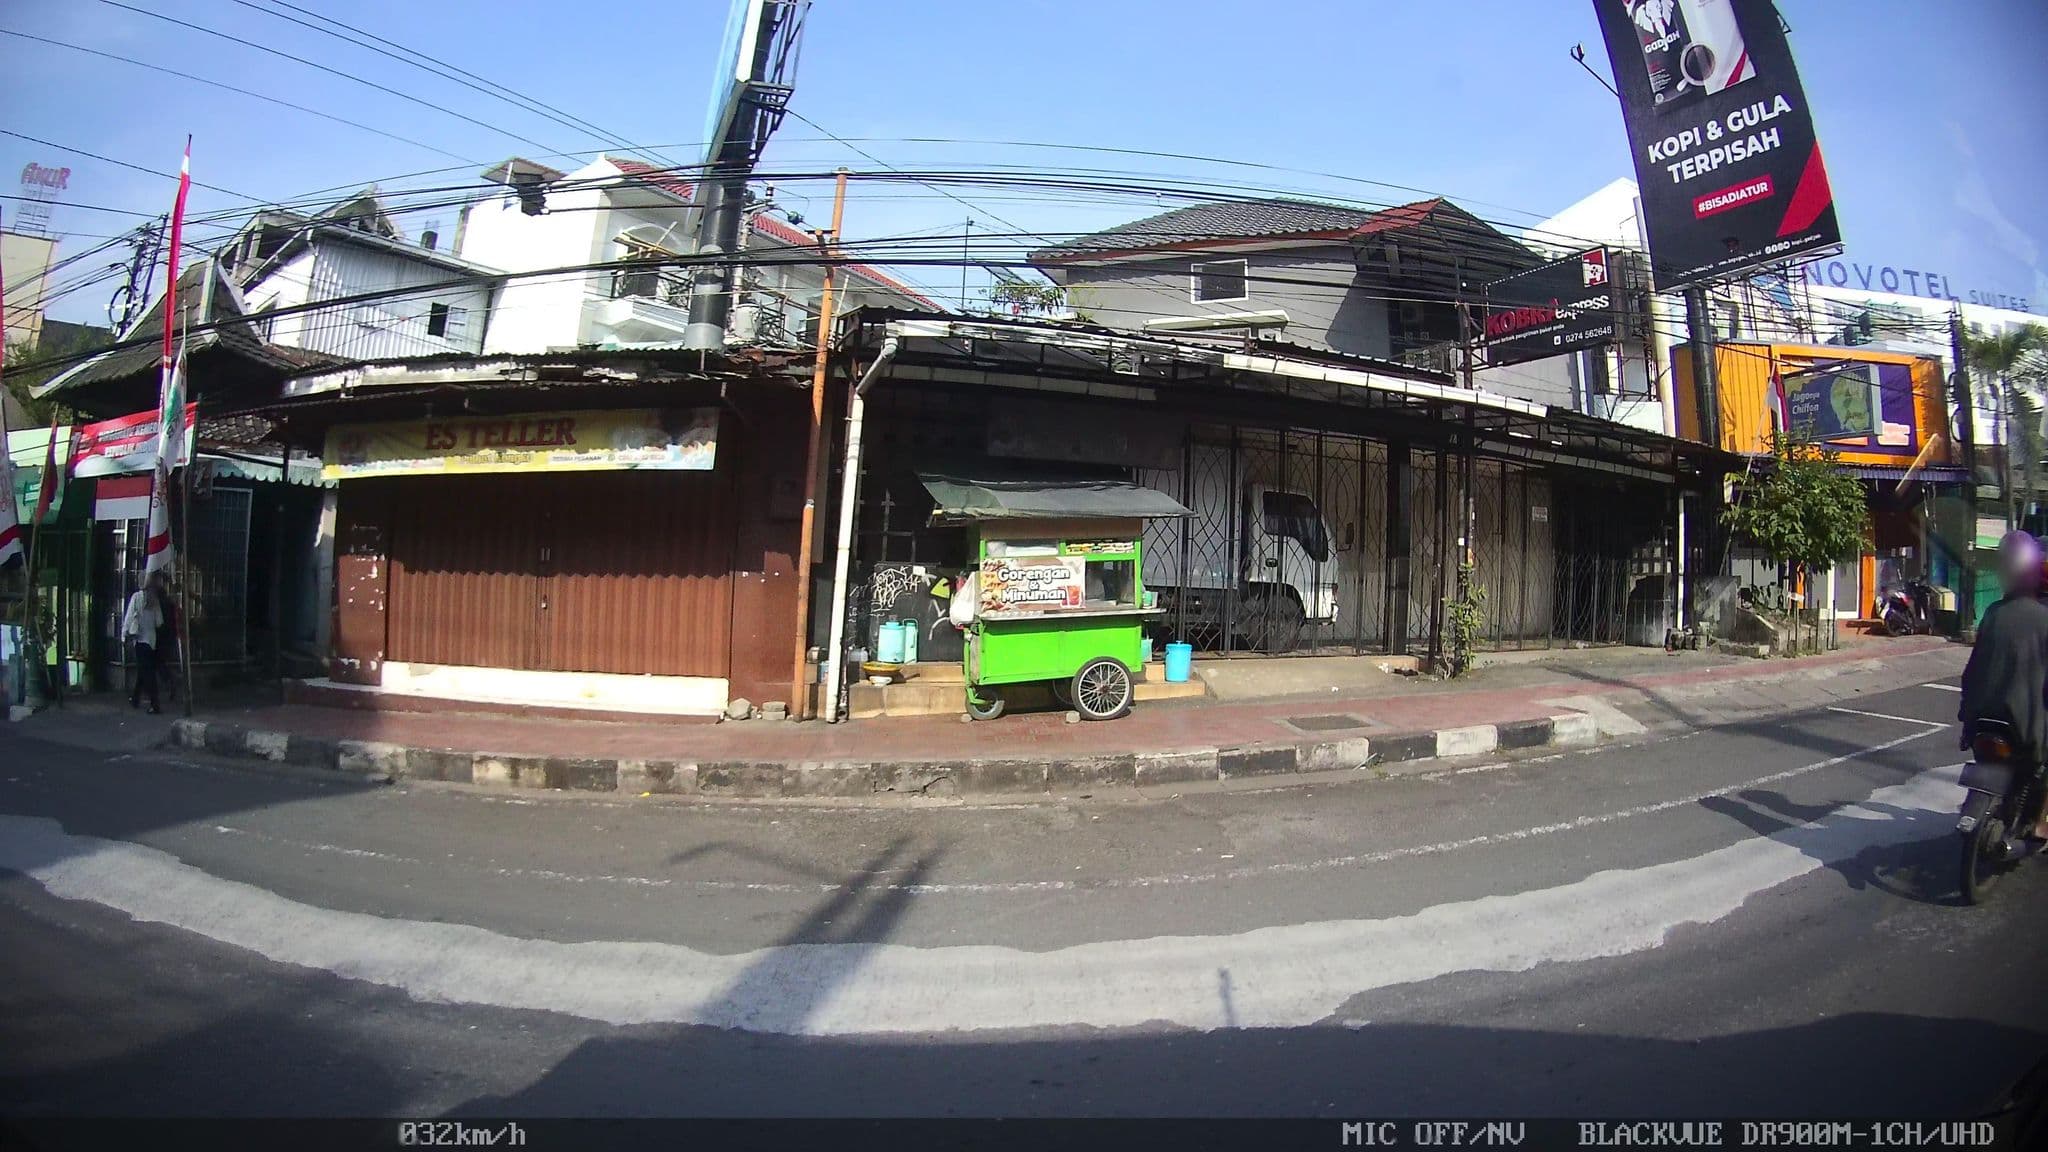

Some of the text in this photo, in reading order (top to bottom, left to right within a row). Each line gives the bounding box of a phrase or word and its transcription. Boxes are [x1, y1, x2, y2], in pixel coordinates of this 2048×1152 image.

[1648, 94, 1792, 164] KOPI & GULA
[1667, 127, 1781, 184] TERPISAH
[1698, 182, 1768, 213] #BISADIATUR
[1801, 260, 2029, 312] NOVOTEL SUITES
[1565, 331, 1584, 344] 0274
[426, 417, 577, 450] ES TELLER
[998, 568, 1070, 583] Gorengan
[1029, 580, 1040, 590] &
[1002, 589, 1066, 604] Minuman
